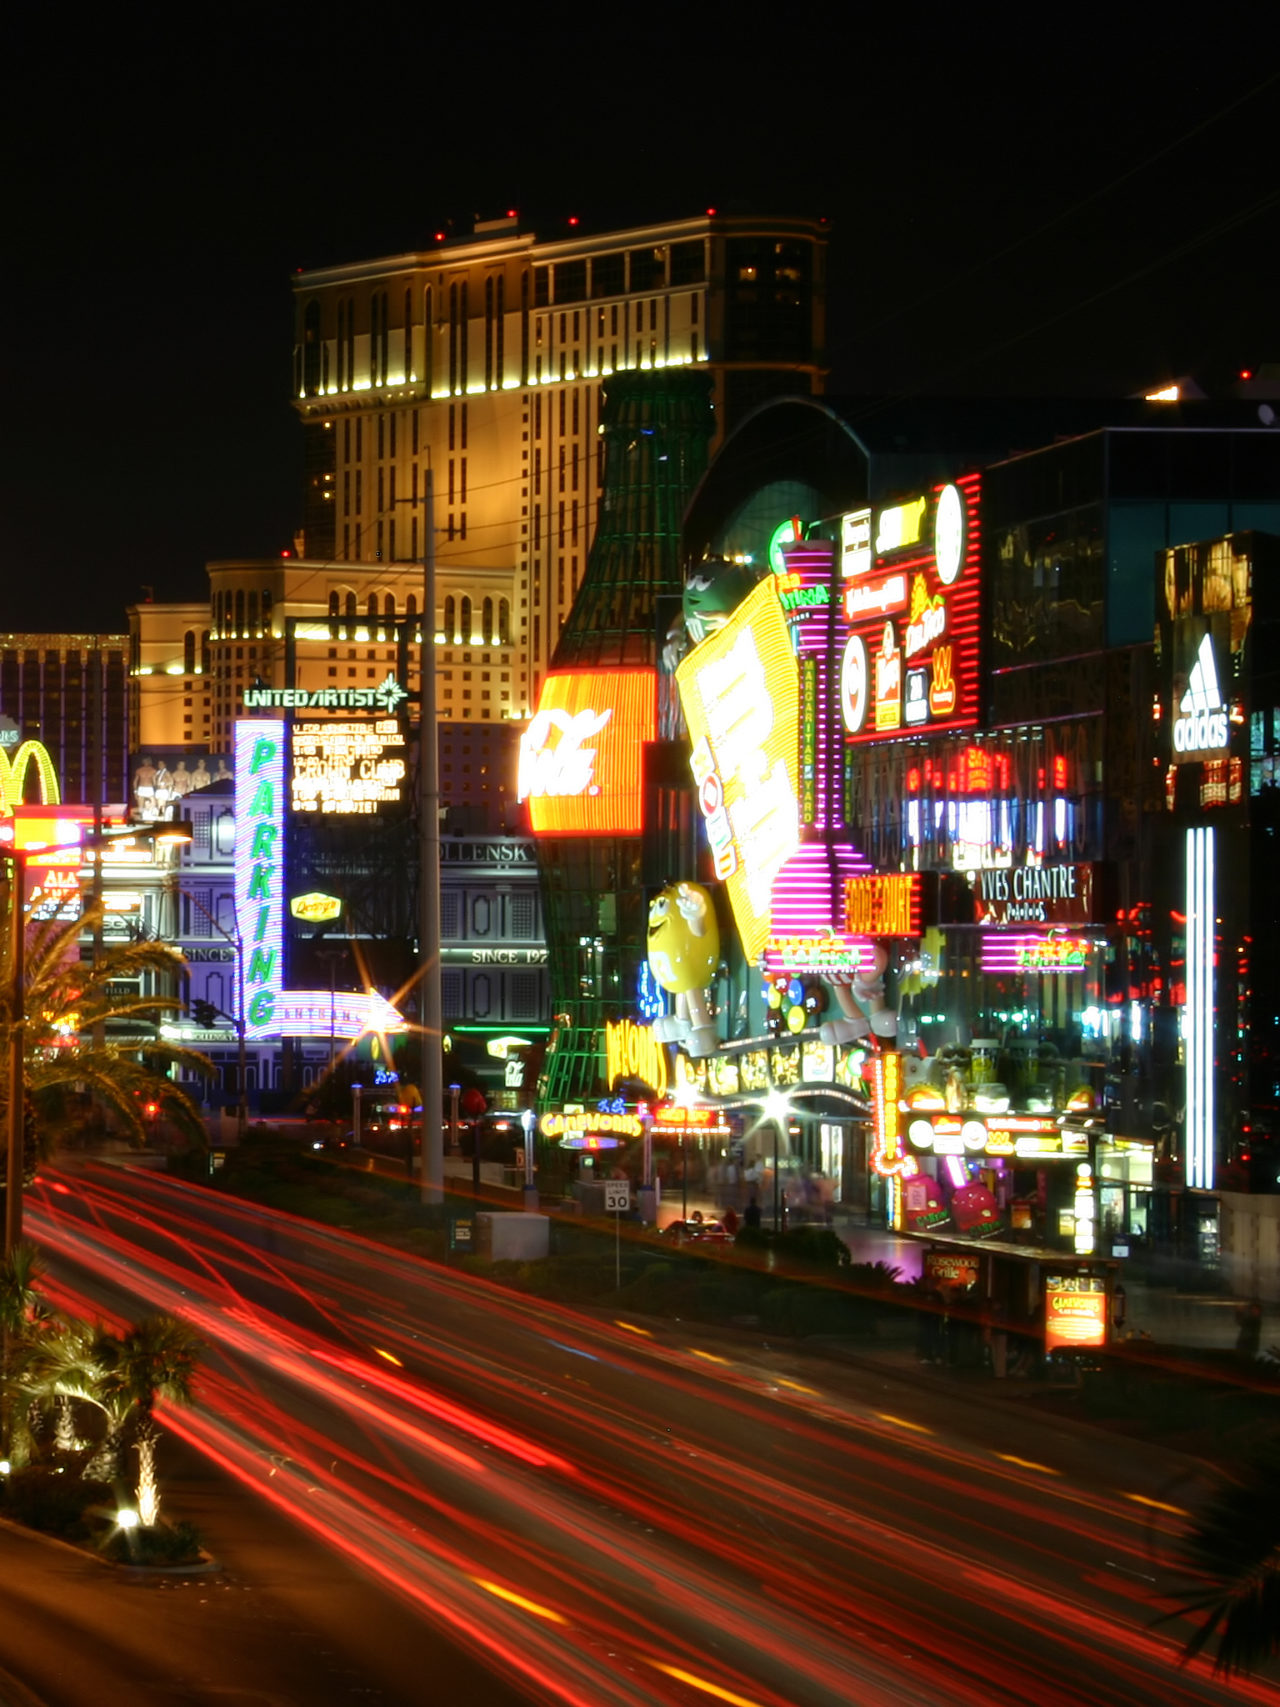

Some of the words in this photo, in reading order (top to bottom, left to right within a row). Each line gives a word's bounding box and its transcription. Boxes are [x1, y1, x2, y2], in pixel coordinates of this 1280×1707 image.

[243, 689, 307, 707] UNITED
[308, 689, 388, 707] ARTISTS
[804, 659, 815, 764] MARGARITAS
[1174, 707, 1228, 752] adidas
[804, 780, 815, 823] YARD
[247, 737, 277, 1027] PARKING
[981, 873, 1009, 901] YVES
[1013, 866, 1076, 899] CHANTRE
[183, 948, 230, 961] SINCE
[472, 951, 518, 964] SINCE
[526, 951, 548, 964] 197
[540, 1112, 642, 1137] GAMEWORKS
[607, 1196, 627, 1208] 30
